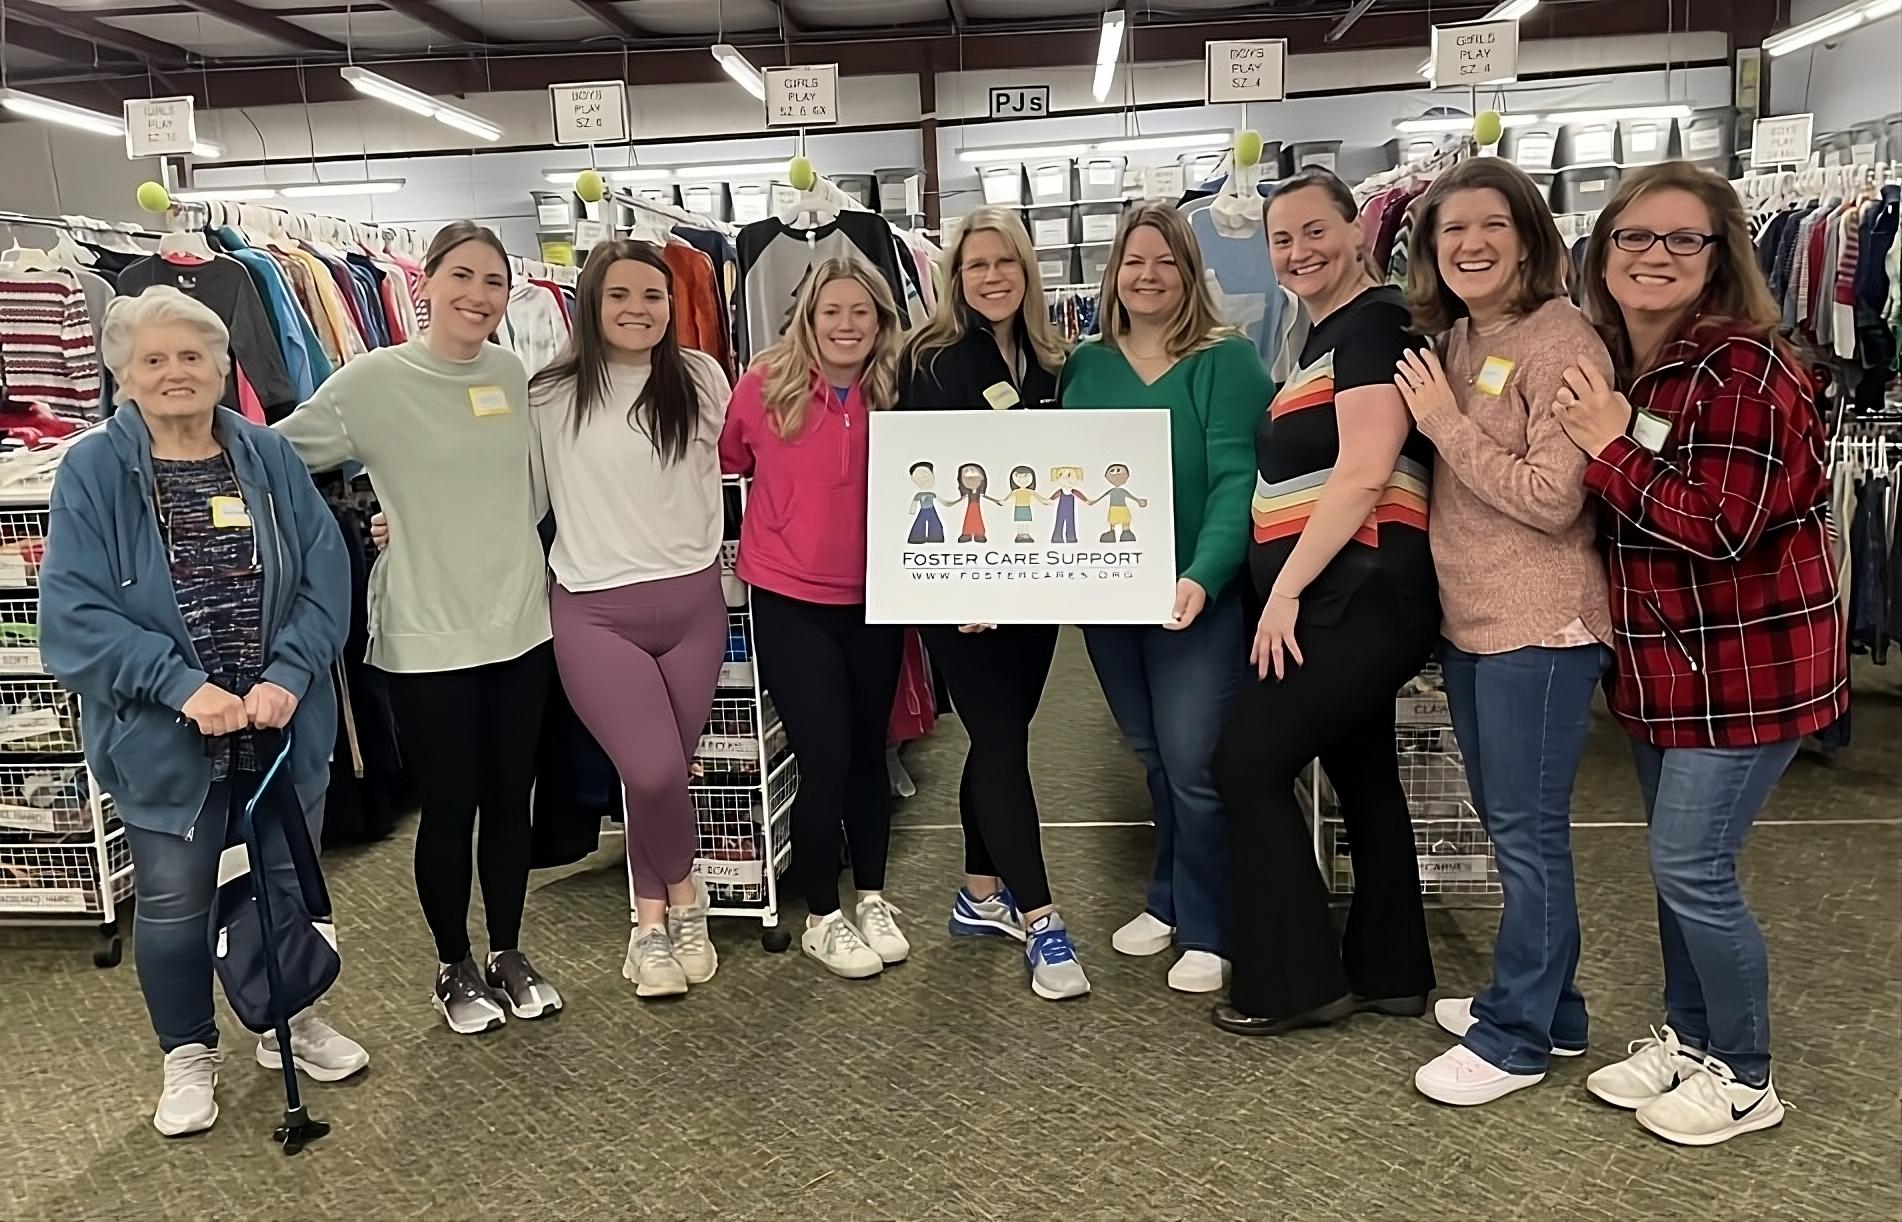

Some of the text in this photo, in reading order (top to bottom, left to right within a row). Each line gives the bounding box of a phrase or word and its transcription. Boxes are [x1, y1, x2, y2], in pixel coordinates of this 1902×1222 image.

[1460, 49, 1491, 60] PLAY
[784, 78, 818, 88] GIRLS
[788, 93, 816, 103] PLAY
[996, 92, 1042, 113] PJs
[903, 551, 1143, 566] FOSTER CARE SUPPORT
